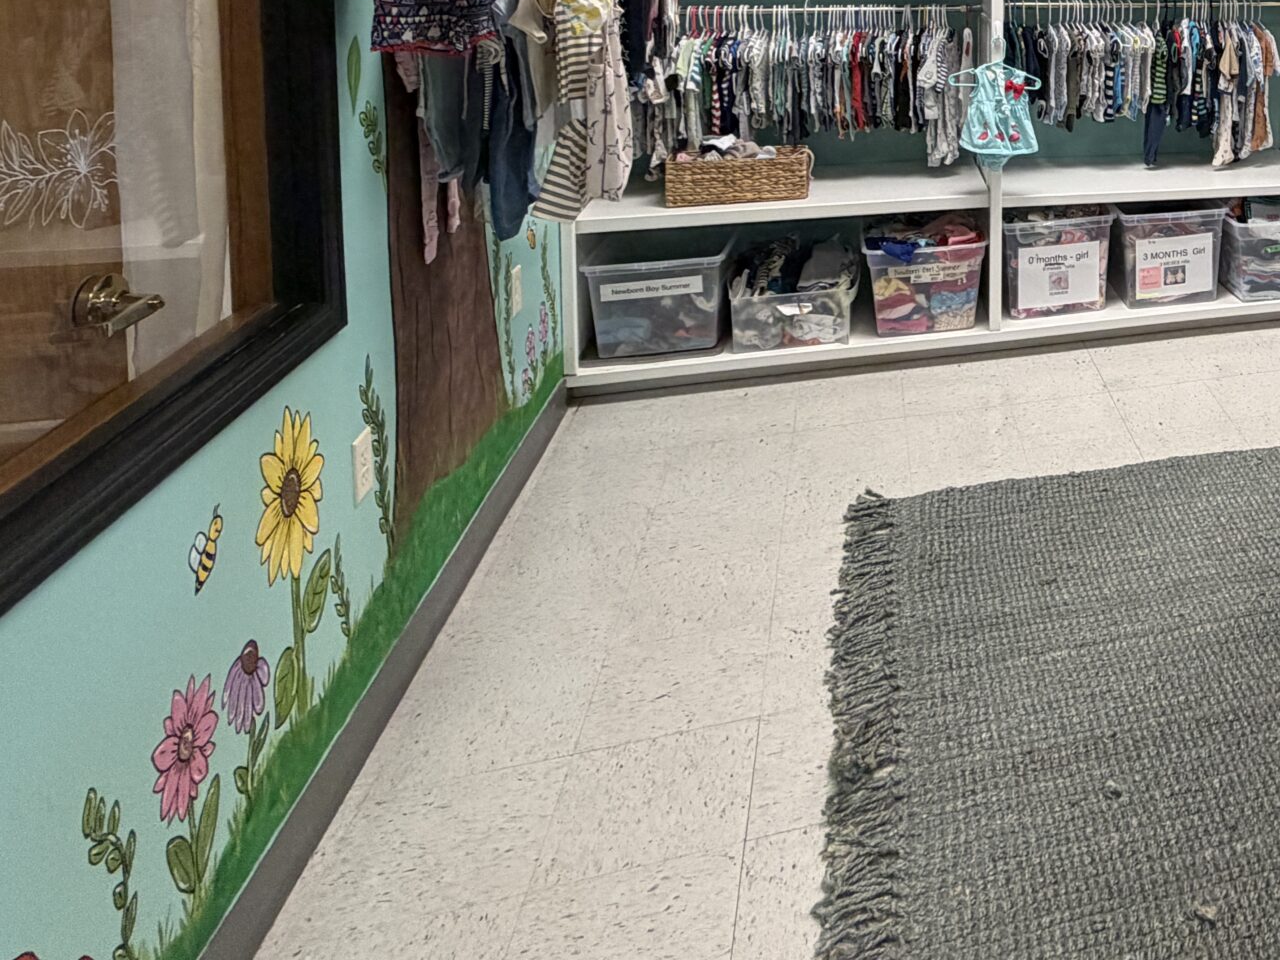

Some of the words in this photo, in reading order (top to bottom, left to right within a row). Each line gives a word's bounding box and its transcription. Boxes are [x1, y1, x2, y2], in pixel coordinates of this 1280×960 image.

[1028, 256, 1034, 265] 0
[1036, 253, 1068, 264] months
[1075, 251, 1089, 261] girl
[1143, 253, 1149, 261] 3
[1150, 249, 1188, 260] MONTHS
[1192, 247, 1206, 256] Girl
[661, 283, 690, 291] Summer
